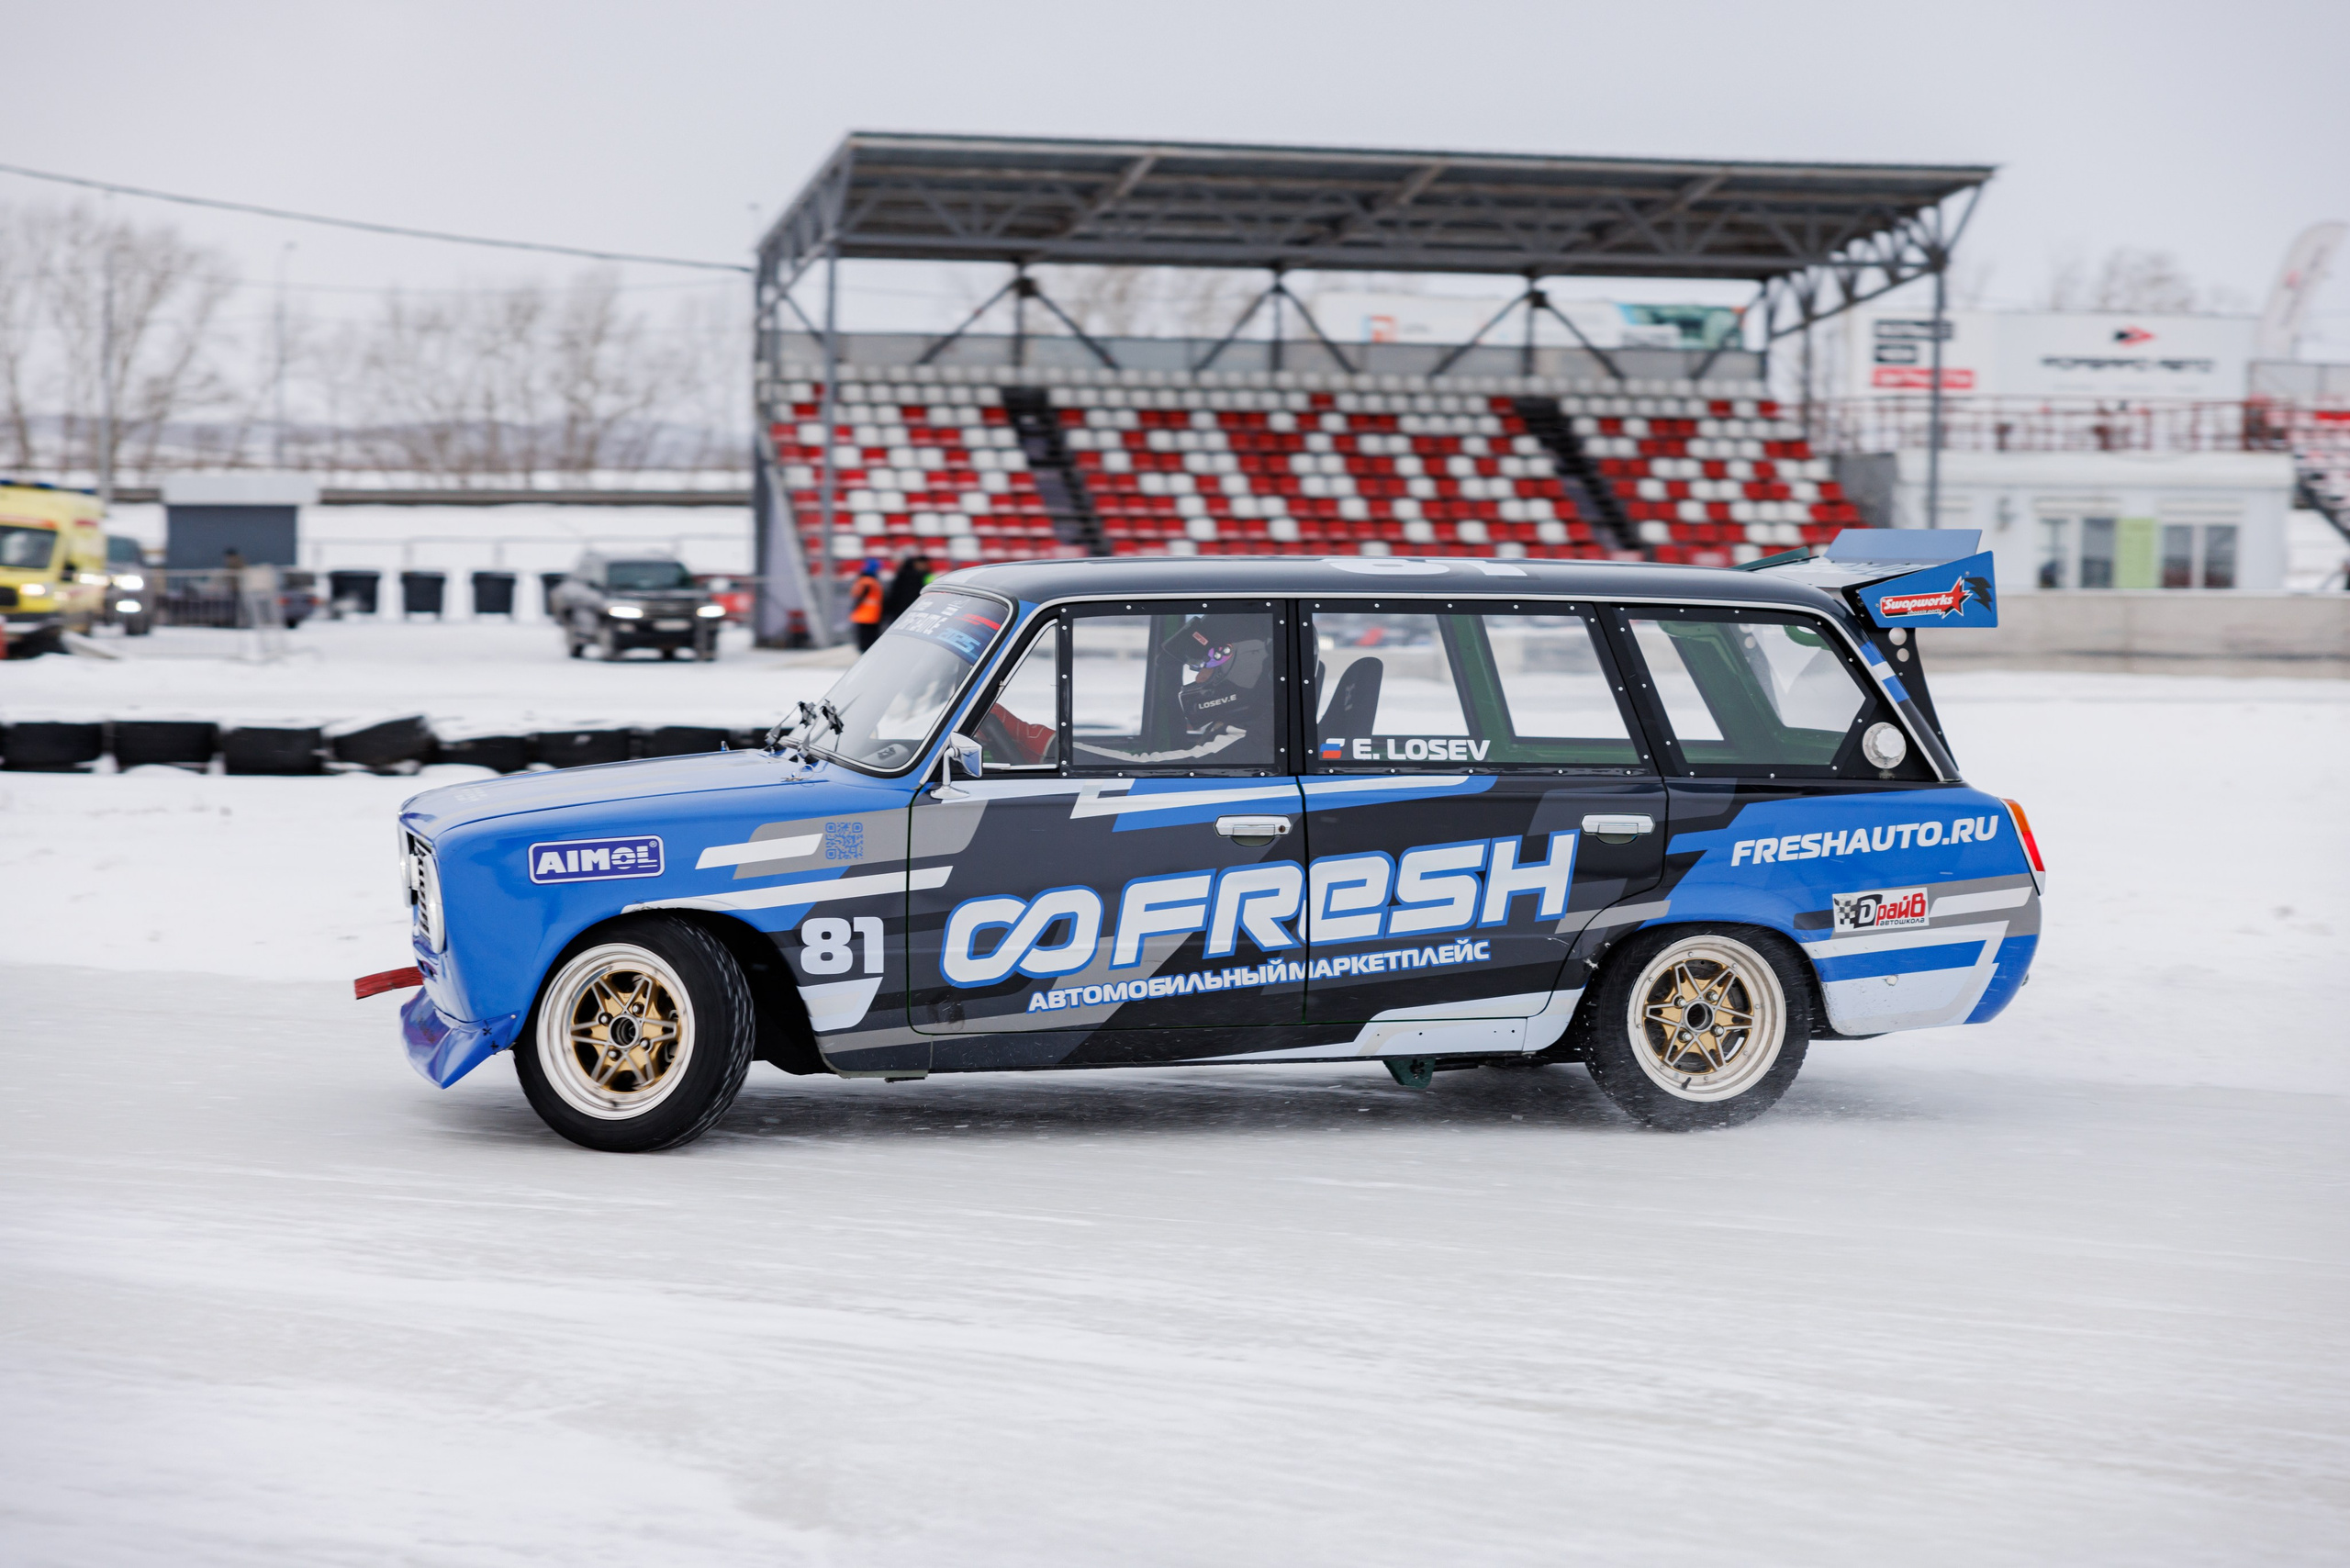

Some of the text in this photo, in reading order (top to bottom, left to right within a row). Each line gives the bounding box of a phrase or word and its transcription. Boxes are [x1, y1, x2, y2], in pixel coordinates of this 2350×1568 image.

[1884, 594, 1953, 610] Swapworks
[1198, 694, 1237, 710] LOSEV.E
[1352, 738, 1491, 761] E. LOSEV
[1730, 815, 1998, 867] FRESHAUTO.RU
[800, 916, 884, 974] 81
[1028, 939, 1491, 1013] АВТОМОБИЛЬНЫЙ МАРКЕТПЛЕЙС
